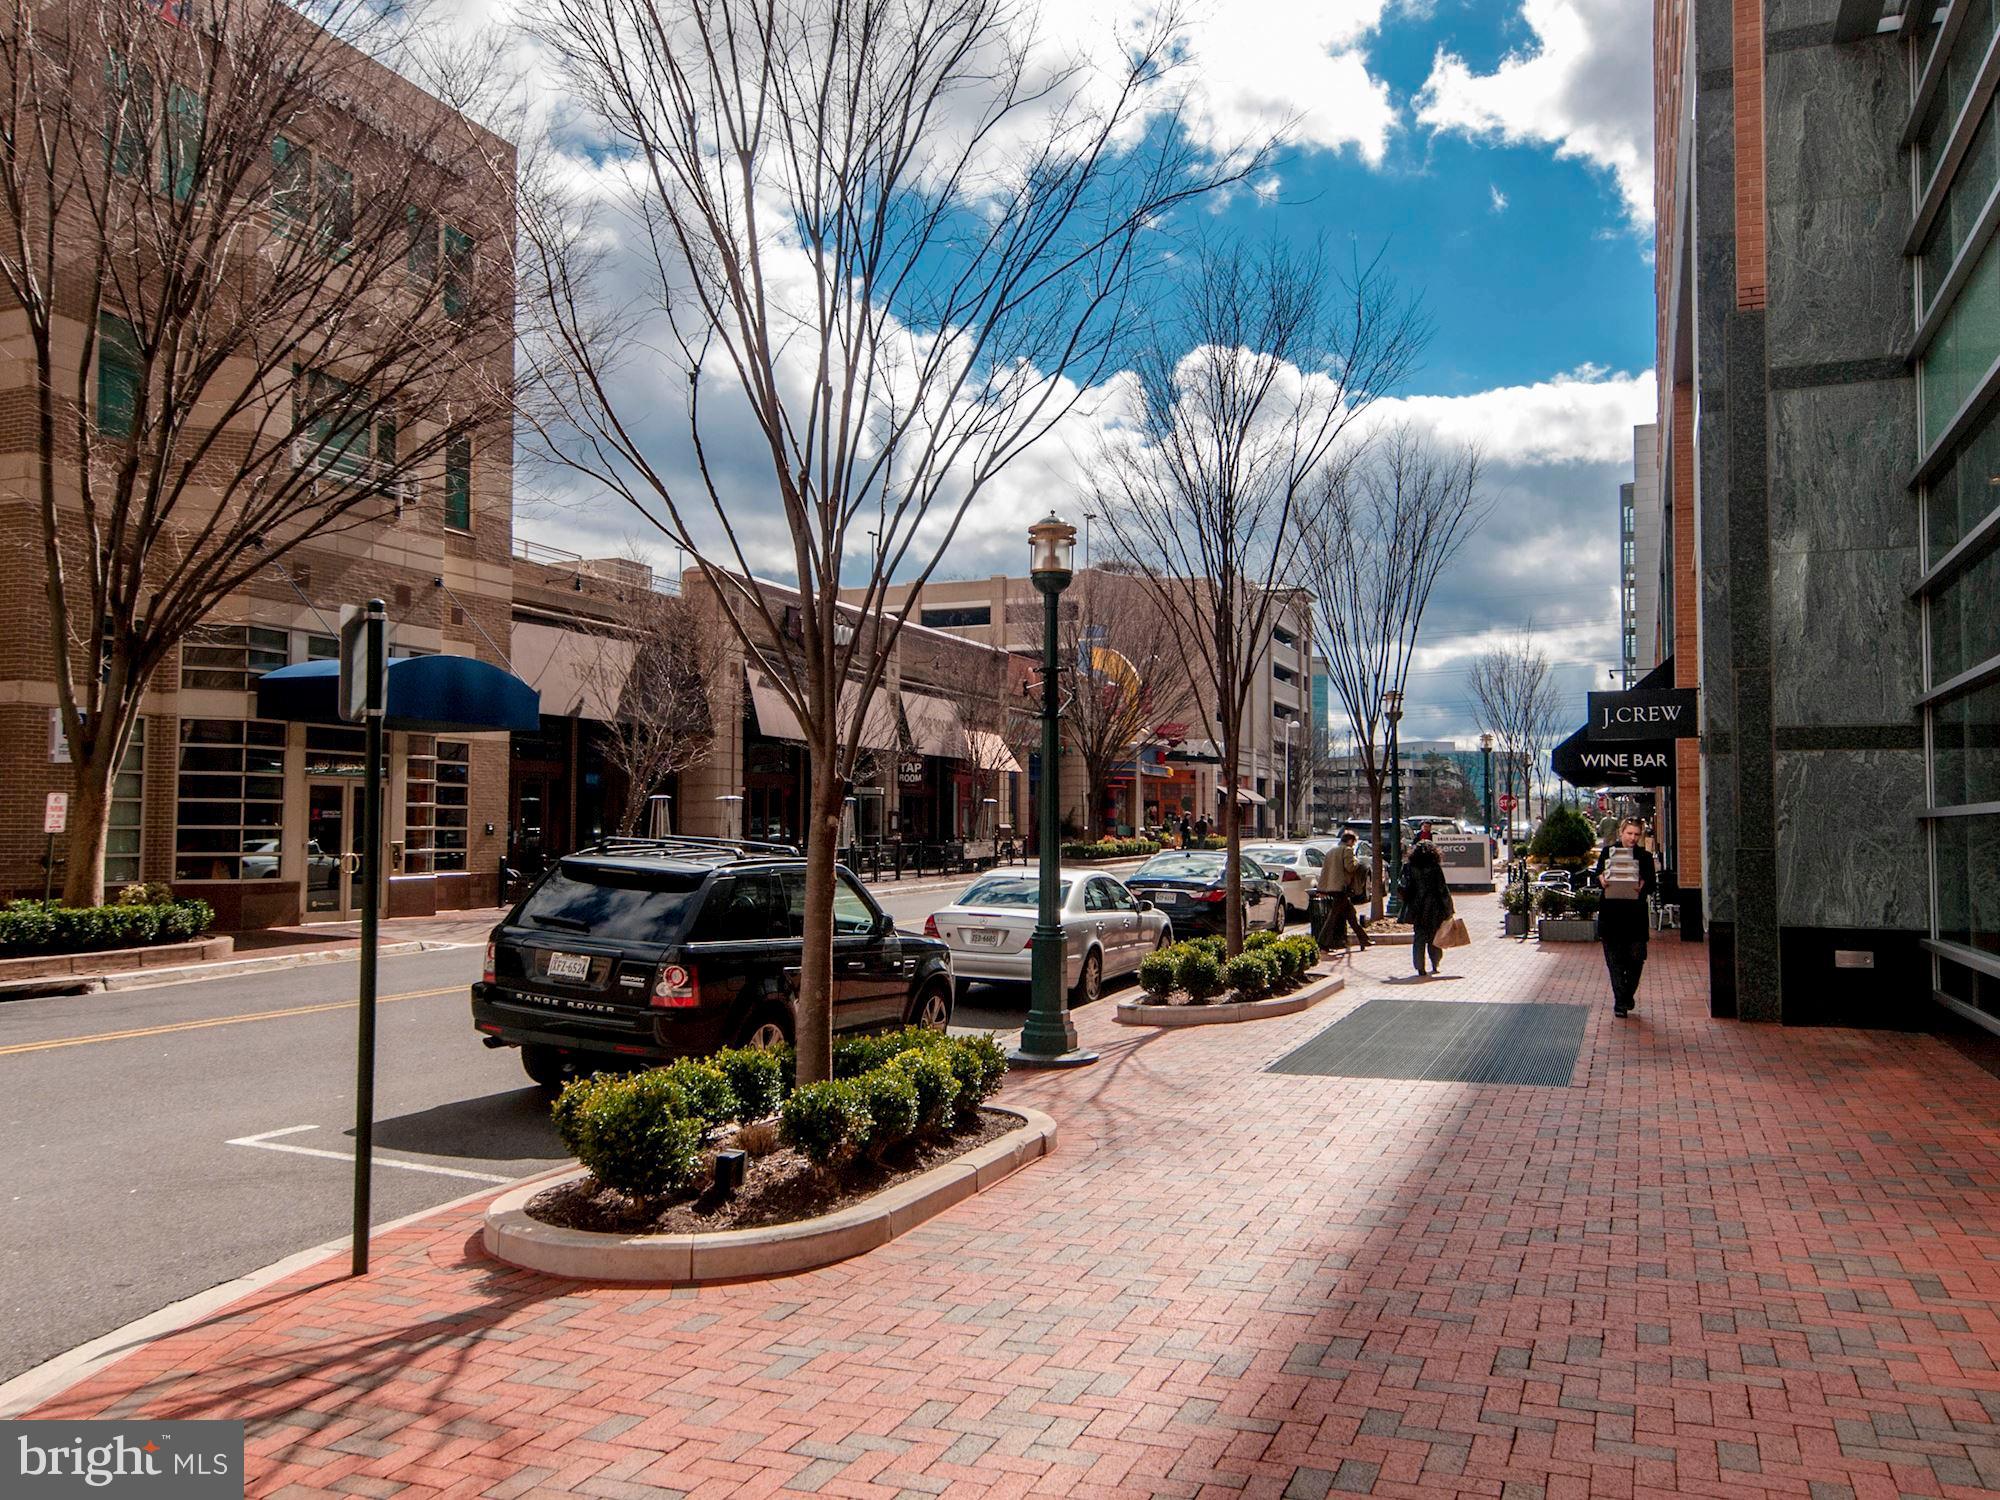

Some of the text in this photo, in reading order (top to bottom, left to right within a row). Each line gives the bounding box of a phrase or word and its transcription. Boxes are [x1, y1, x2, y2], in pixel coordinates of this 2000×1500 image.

[1602, 705, 1681, 729] J.CREW
[1581, 753, 1668, 767] WINE BAR
[901, 762, 922, 773] TAP
[899, 773, 921, 783] ROOM
[516, 993, 615, 1013] RANGE ROVER
